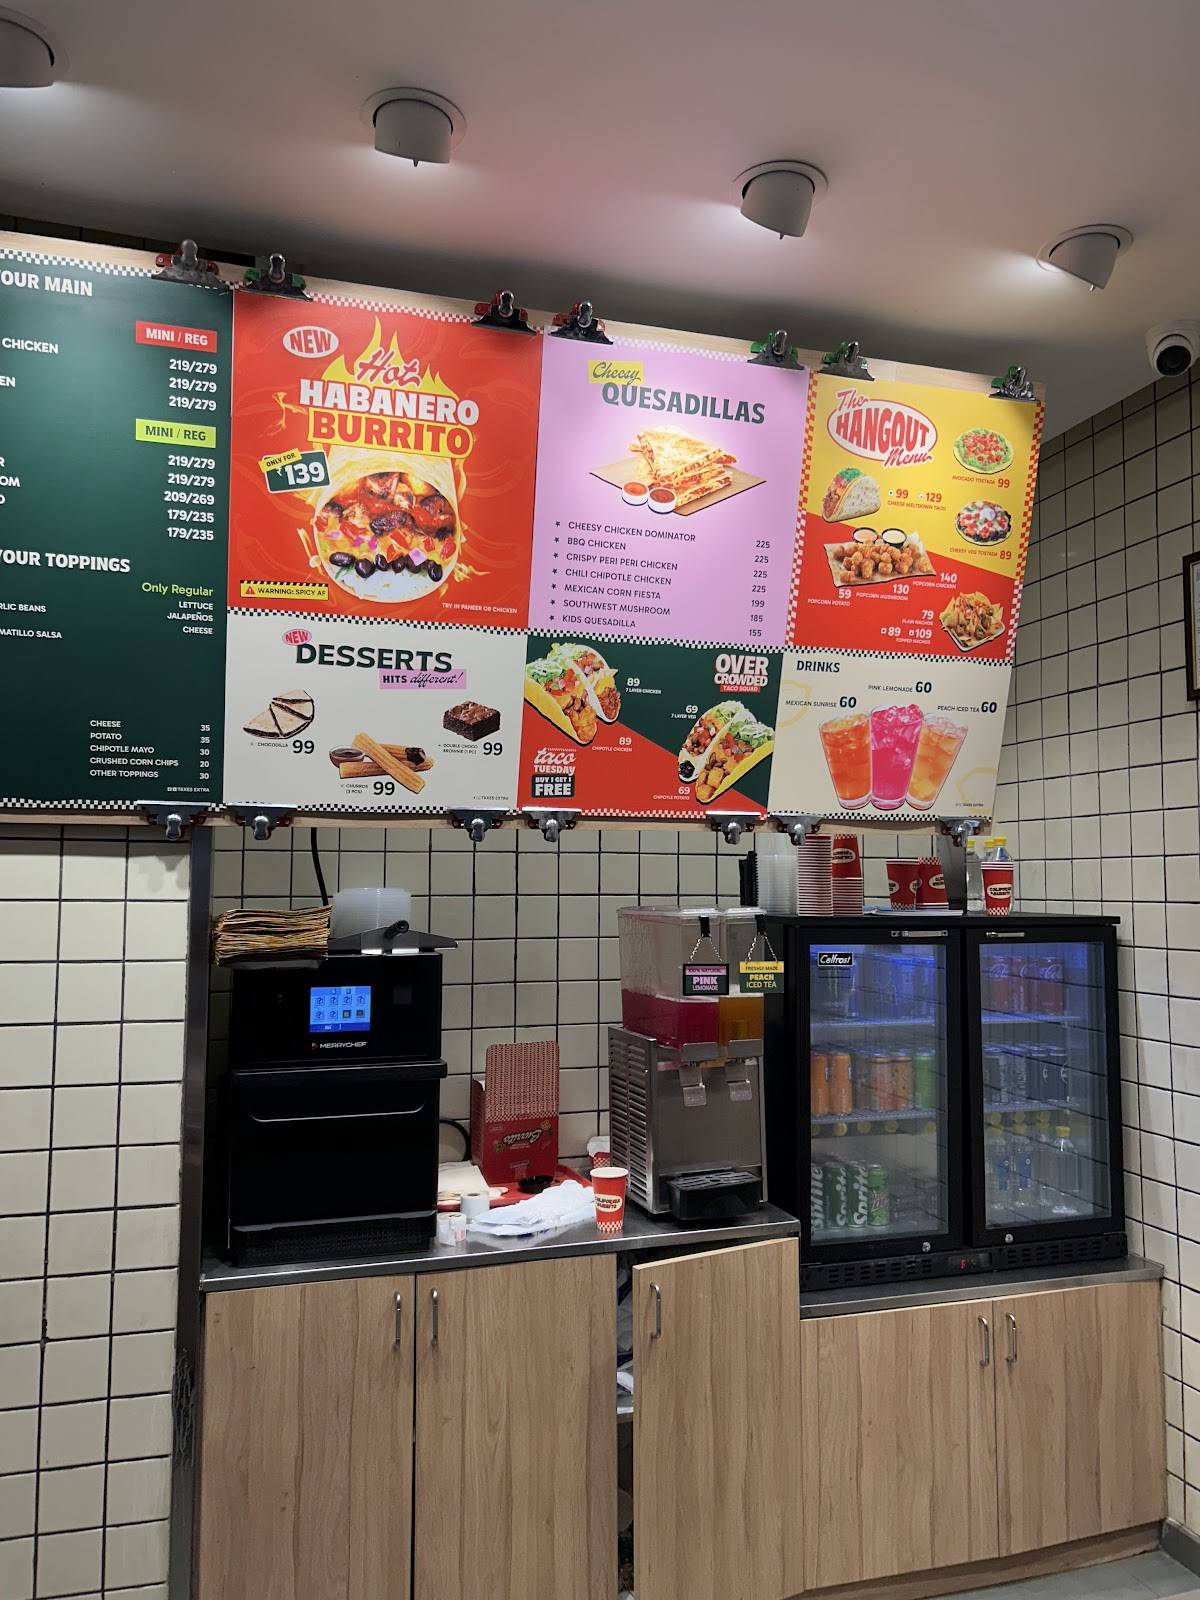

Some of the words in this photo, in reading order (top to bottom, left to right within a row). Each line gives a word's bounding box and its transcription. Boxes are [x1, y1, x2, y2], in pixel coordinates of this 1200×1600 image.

[0, 269, 40, 290] OUR
[44, 276, 93, 296] MAIN
[146, 328, 175, 342] MINI
[177, 328, 182, 342] /
[184, 333, 208, 346] REG
[288, 330, 332, 355] NEW
[2, 338, 59, 354] CHICKEN
[169, 358, 218, 375] 219/279
[357, 347, 420, 388] Hot
[592, 362, 642, 385] Cheesy
[168, 377, 217, 394] 219/279
[168, 396, 216, 412] 219/279
[299, 378, 480, 426] HABANERO
[602, 382, 766, 424] QUESADILLAS
[837, 388, 869, 412] The
[145, 425, 174, 438] MINI
[176, 426, 181, 439] /
[183, 429, 206, 442] REG
[312, 410, 472, 456] BURRITO
[835, 407, 930, 454] HANGOUT
[168, 455, 216, 470] 219/279
[266, 458, 282, 467] ONLY
[283, 452, 296, 462] FOR
[884, 446, 932, 468] Menu
[168, 473, 215, 488] 219/279
[998, 478, 1010, 488] 99
[164, 490, 214, 506] 209/269
[896, 488, 909, 499] 99
[926, 492, 942, 502] 129
[167, 509, 214, 524] 179/235
[167, 528, 214, 542] 179/235
[568, 521, 602, 532] CHEESY
[604, 525, 643, 538] CHICKEN
[644, 529, 696, 542] DOMINATOR
[756, 540, 770, 549] 225
[567, 537, 586, 546] BBQ
[588, 539, 626, 550] CHICKEN
[754, 555, 769, 564] 225
[1000, 550, 1012, 560] 89
[0, 550, 40, 567] OUR
[45, 552, 130, 572] TOPPINGS
[566, 552, 598, 564] CRISPY
[600, 556, 618, 566] PERI
[620, 558, 638, 568] PERI
[640, 560, 678, 571] CHICKEN
[753, 570, 768, 579] 225
[565, 568, 588, 578] CHILI
[590, 570, 632, 582] CHIPOTLE
[634, 574, 672, 586] CHICKEN
[752, 584, 766, 594] 225
[940, 572, 957, 584] 140
[142, 582, 168, 596] Only
[172, 584, 214, 597] Regular
[564, 584, 605, 594] MEXICAN
[606, 587, 632, 598] CORN
[634, 590, 661, 600] FIESTA
[751, 600, 765, 608] 199
[838, 588, 852, 598] 59
[892, 584, 910, 594] 130
[18, 604, 46, 613] BEANS
[178, 601, 214, 610] LETTUCE
[564, 600, 617, 612] SOUTHWEST
[620, 604, 670, 616] MUSHROOM
[750, 614, 764, 623] 185
[167, 611, 214, 622] JALAPEÑOS
[922, 610, 934, 620] 79
[182, 626, 213, 634] CHEESE
[562, 614, 582, 624] KIDS
[584, 616, 636, 628] QUESADILLA
[749, 629, 762, 638] 155
[888, 626, 901, 636] 89
[916, 629, 932, 638] 109
[36, 630, 62, 639] SALSA
[285, 630, 310, 645] NEW
[296, 643, 452, 673] DESSERTS
[714, 654, 770, 676] OVER
[796, 660, 840, 673] DRINKS
[382, 674, 408, 684] HITS
[410, 672, 464, 688] different!
[627, 678, 640, 687] 89
[714, 673, 768, 686] CROWDED
[915, 682, 932, 694] 60
[686, 705, 698, 714] 69
[840, 696, 856, 708] 60
[980, 702, 998, 714] 60
[90, 720, 122, 728] CHEESE
[200, 724, 210, 732] 35
[90, 732, 122, 740] POTATO
[619, 736, 632, 746] 89
[90, 744, 129, 753] CHIPOTLE
[130, 746, 154, 754] MAYO
[292, 740, 314, 754] 99
[483, 742, 503, 756] 99
[90, 757, 128, 766] CRUSHED
[130, 758, 154, 766] CORN
[155, 759, 178, 767] CHIPS
[534, 748, 576, 765] taco
[90, 769, 117, 777] OTHER
[118, 770, 158, 778] TOPPINGS
[374, 781, 395, 796] 99
[536, 784, 572, 796] FREE
[678, 786, 690, 795] 69
[820, 954, 851, 964] Celfrost
[692, 976, 718, 984] PINK
